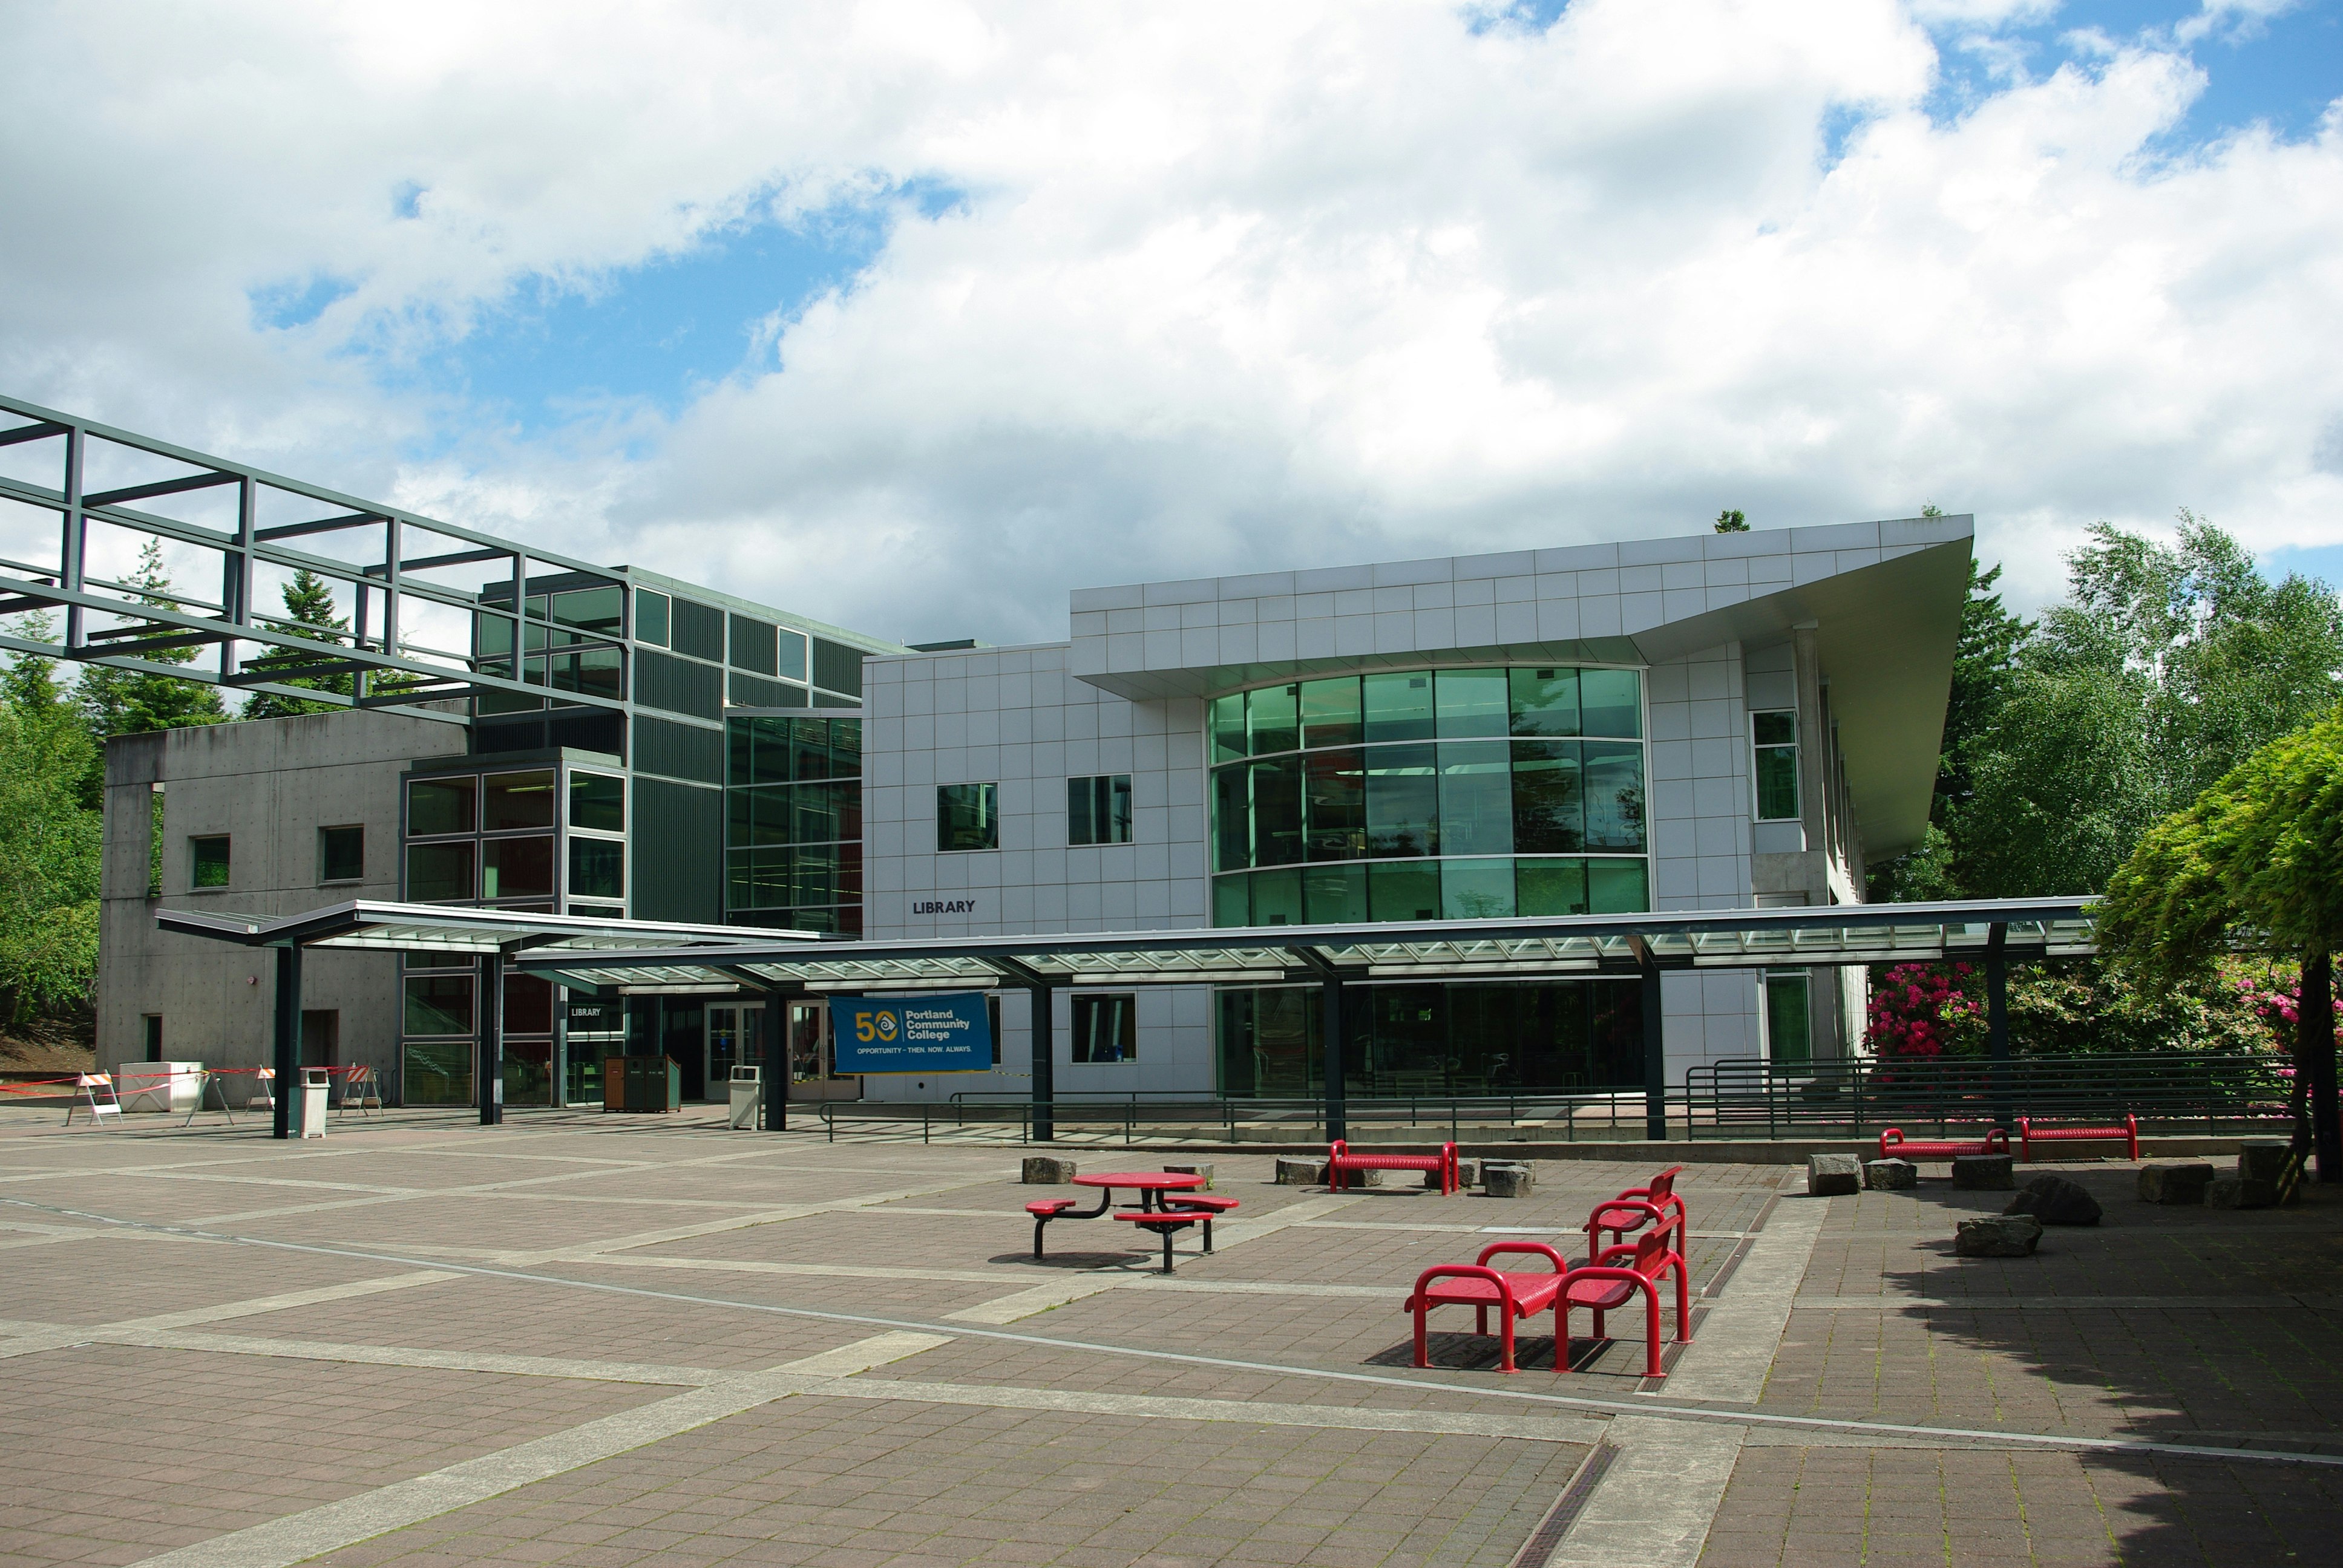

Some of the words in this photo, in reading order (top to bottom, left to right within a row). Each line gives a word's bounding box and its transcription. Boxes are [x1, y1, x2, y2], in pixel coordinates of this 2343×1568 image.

[914, 900, 975, 914] LIBRARY
[571, 1008, 601, 1016] LIBRARY
[906, 1010, 953, 1019] Portland
[906, 1019, 969, 1030] Community
[908, 1030, 950, 1041] College
